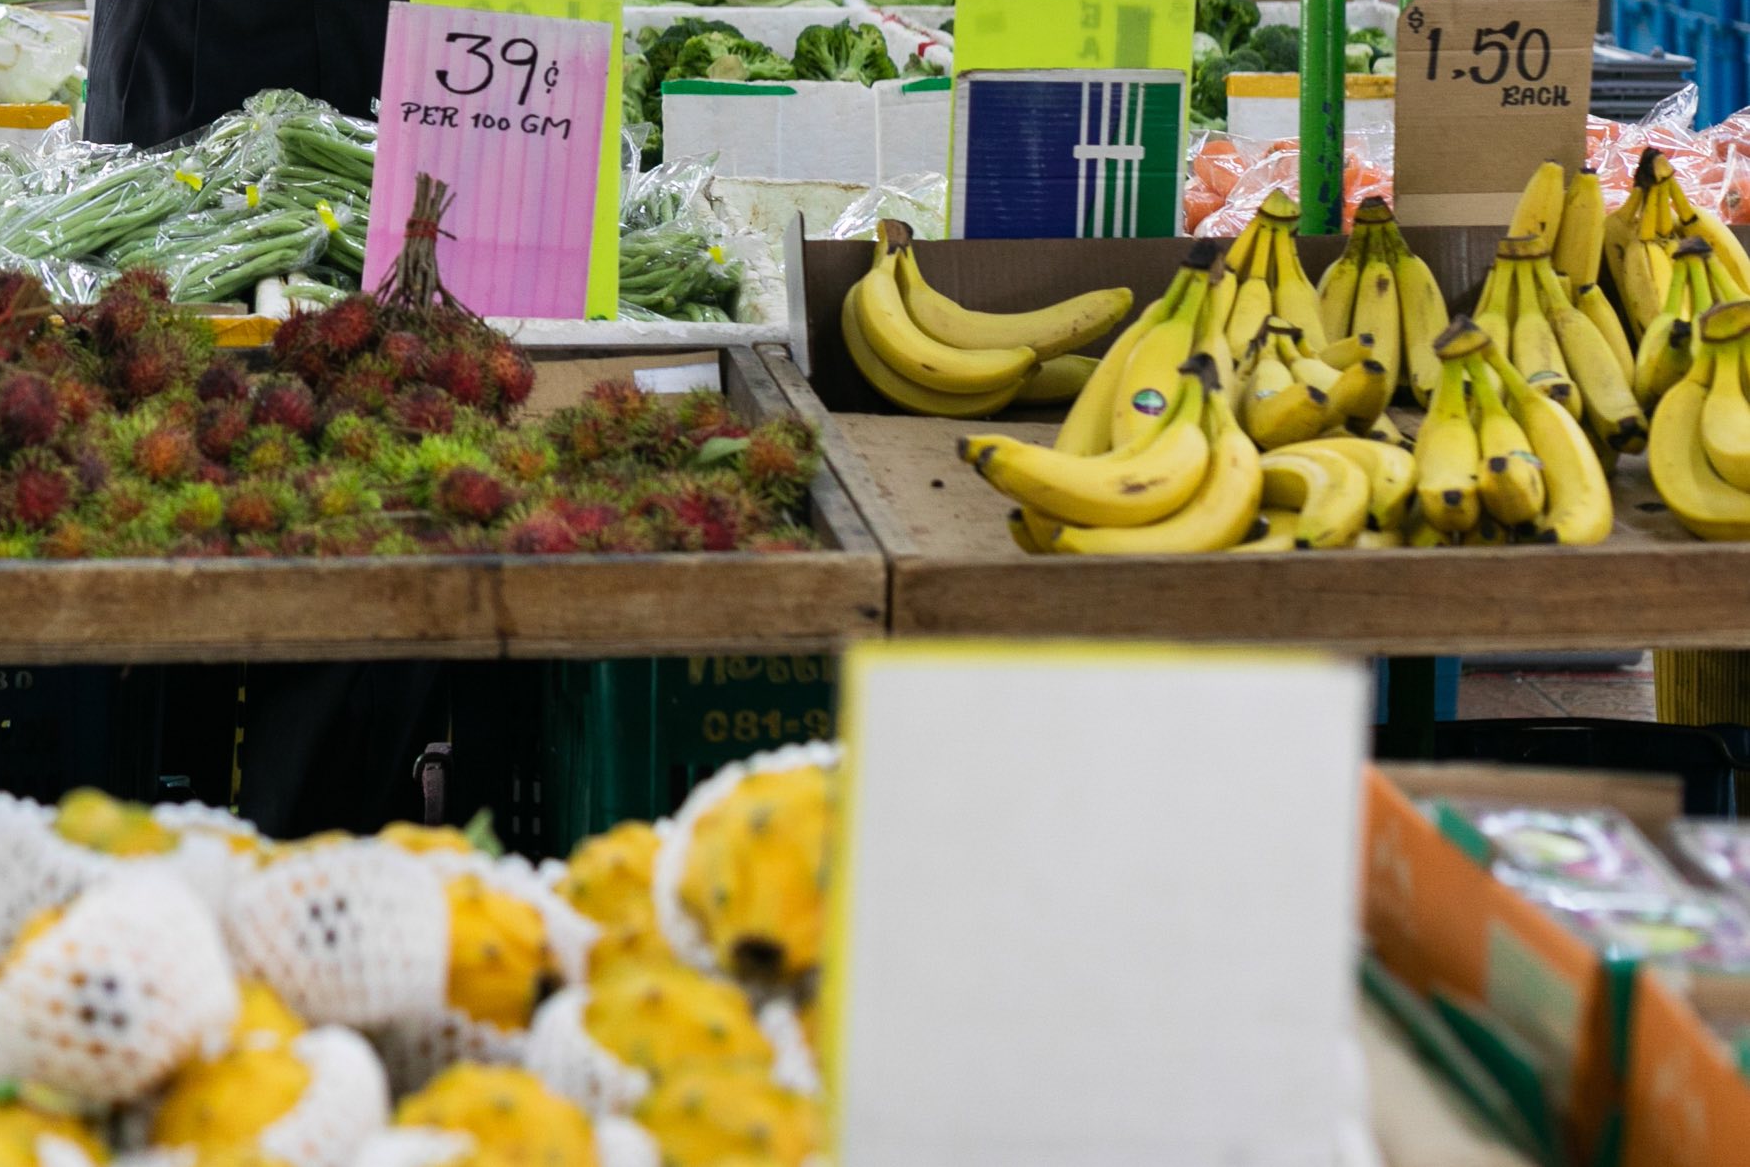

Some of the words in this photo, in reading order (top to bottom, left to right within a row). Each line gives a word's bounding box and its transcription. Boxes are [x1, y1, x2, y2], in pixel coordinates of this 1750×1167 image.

[1502, 85, 1571, 107] EACH
[401, 102, 459, 128] PER
[471, 113, 511, 131] 100
[521, 114, 571, 140] GM
